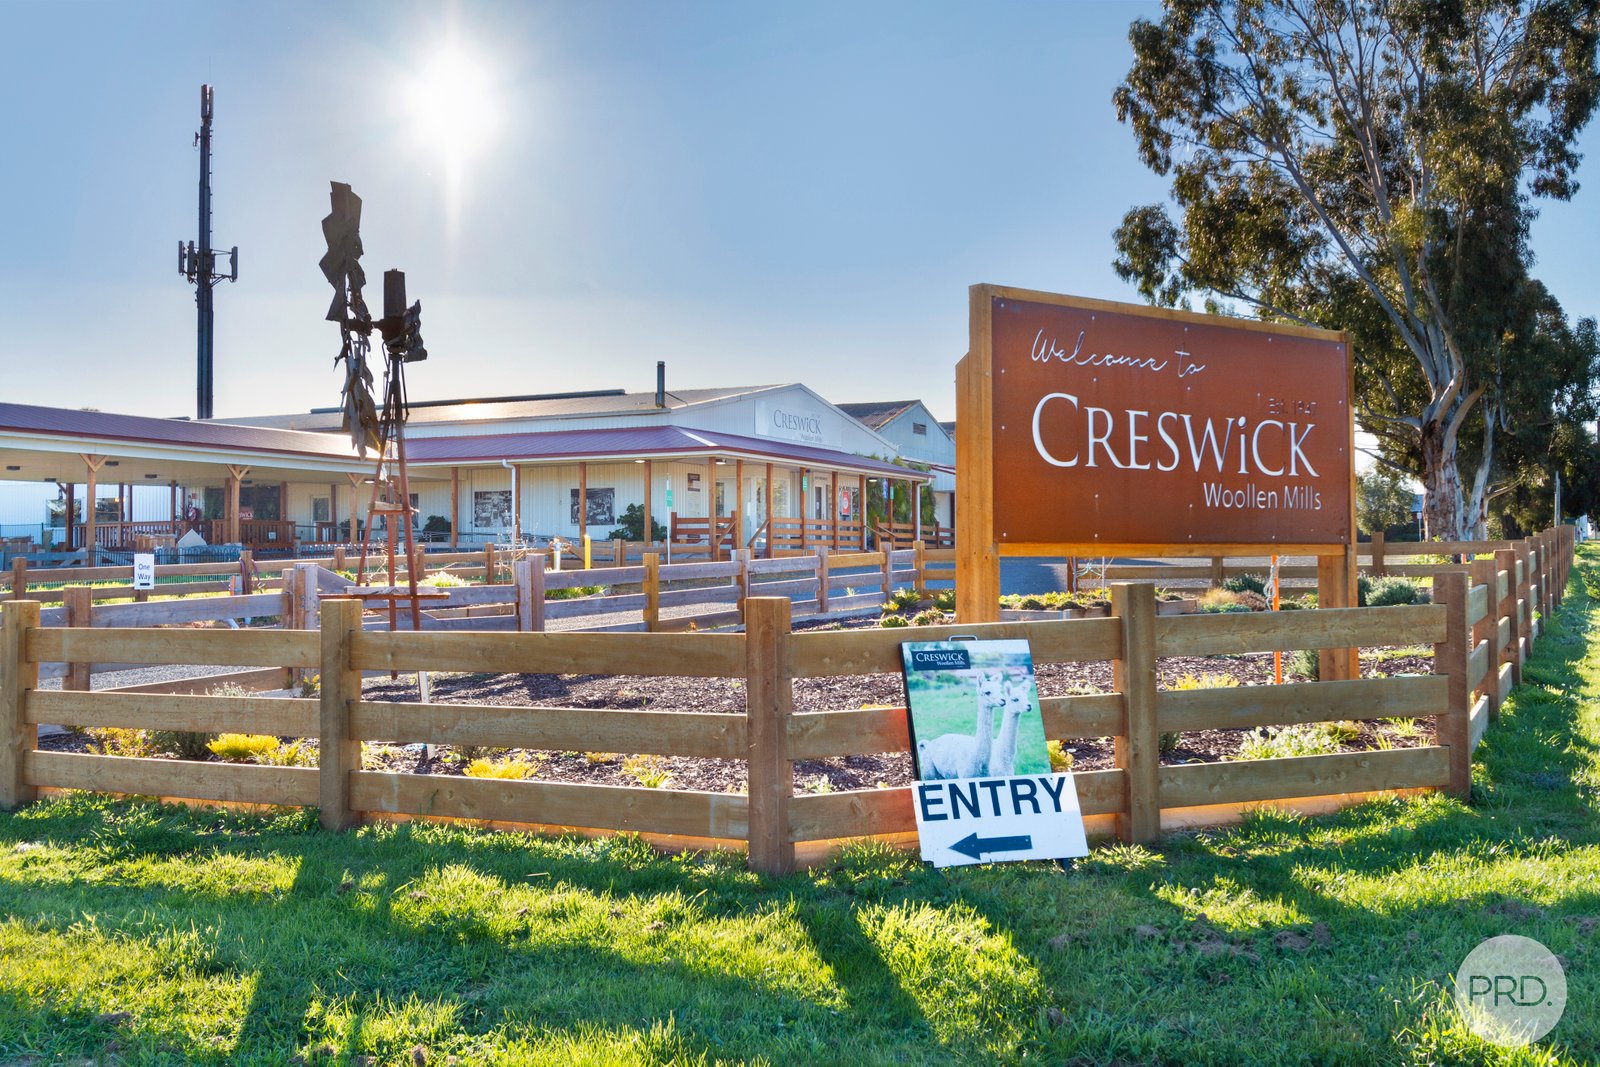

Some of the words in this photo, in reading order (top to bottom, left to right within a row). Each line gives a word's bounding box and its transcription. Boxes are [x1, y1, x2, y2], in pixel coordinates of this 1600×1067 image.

[1031, 328, 1168, 372] Welcome
[1174, 346, 1206, 378] to
[1203, 481, 1279, 509] Woollen
[1283, 485, 1322, 511] Mills
[137, 573, 152, 582] Way
[138, 563, 151, 571] One
[917, 776, 1067, 822] ENTRY
